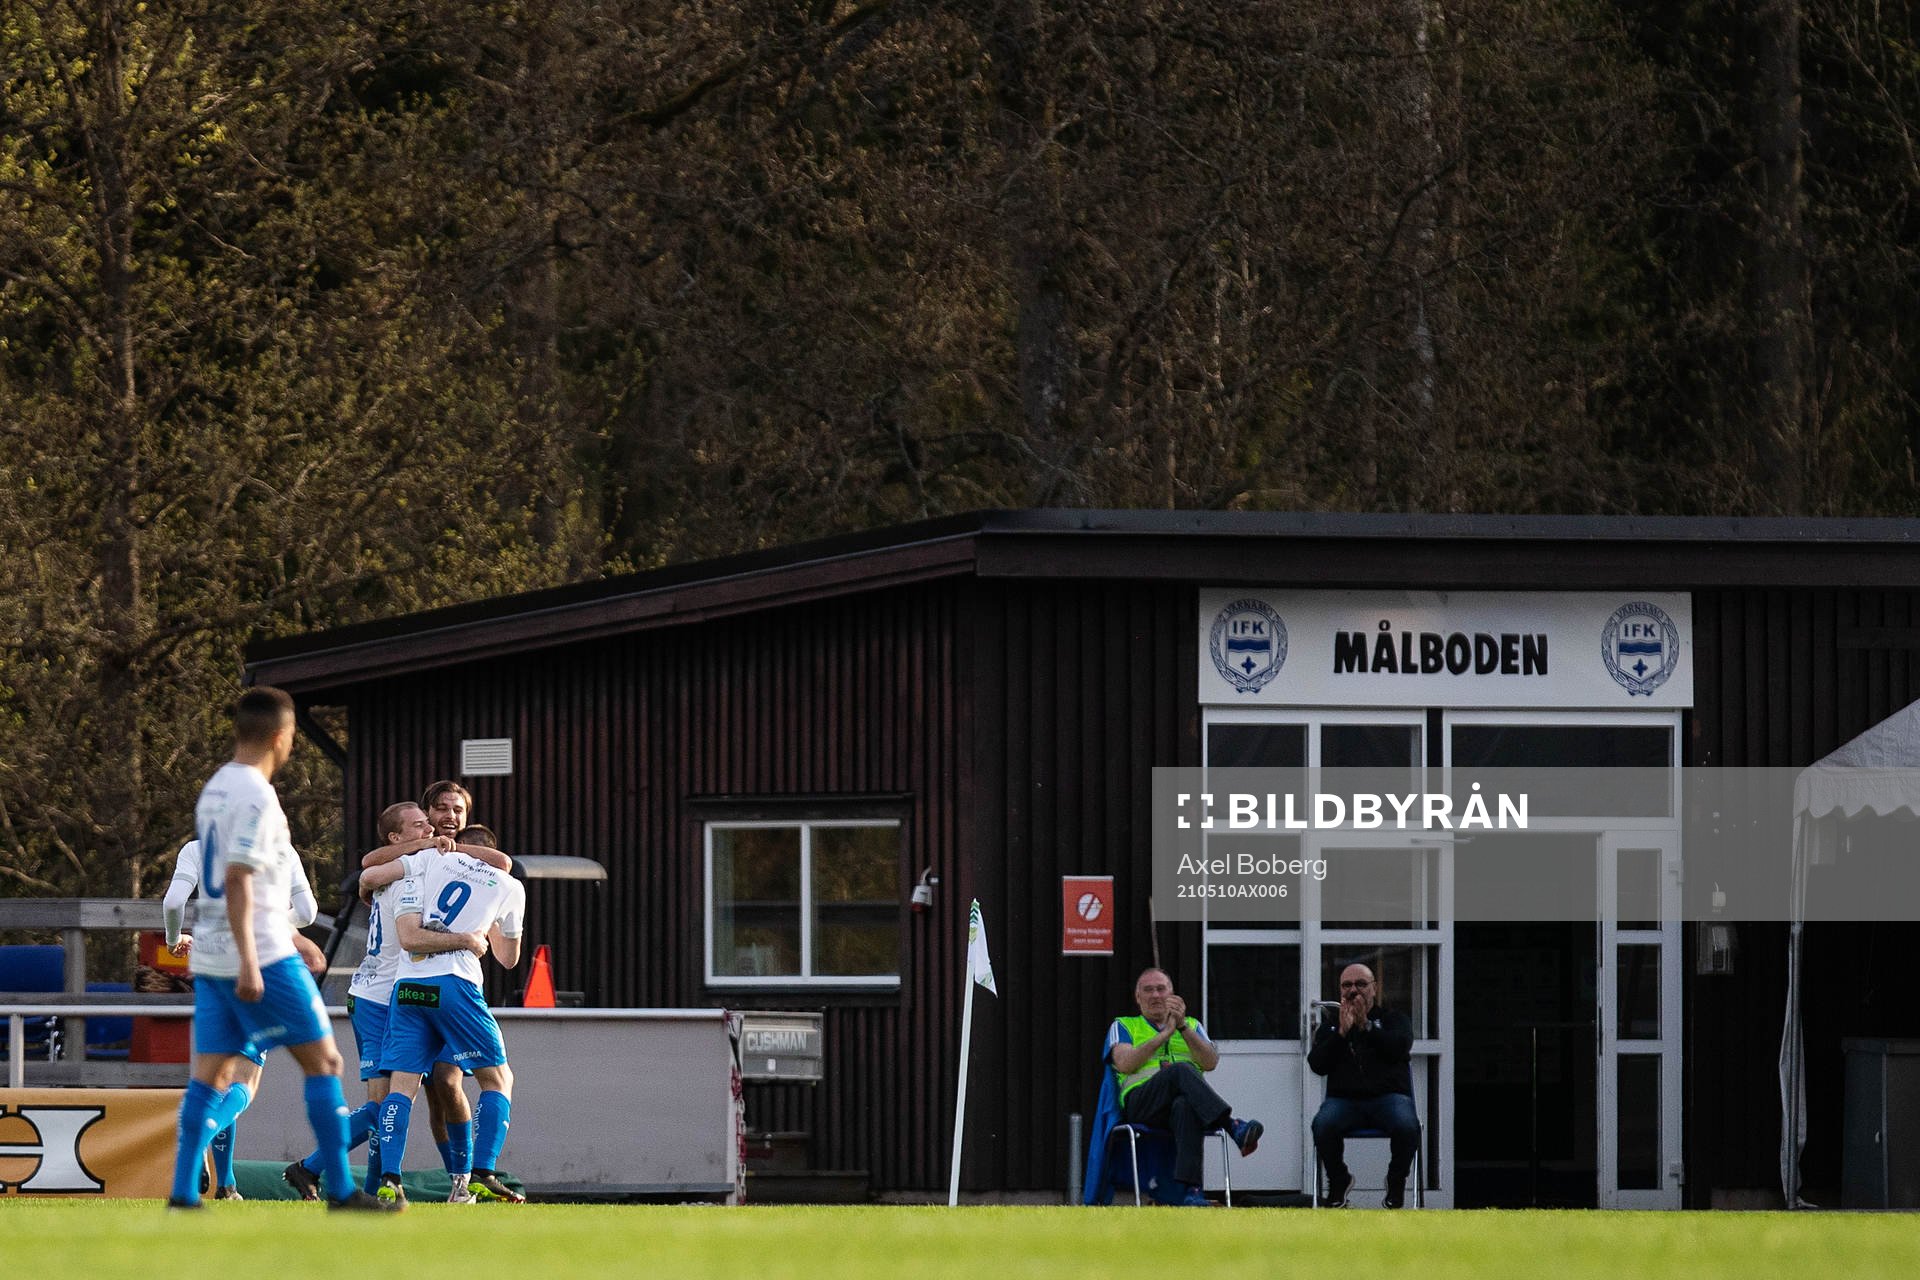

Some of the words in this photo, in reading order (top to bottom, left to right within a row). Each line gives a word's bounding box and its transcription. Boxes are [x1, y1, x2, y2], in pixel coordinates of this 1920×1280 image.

[1233, 620, 1265, 635] IFK
[1624, 623, 1656, 638] IFK
[1333, 619, 1549, 676] MÅLBODEN
[430, 880, 473, 927] 9
[747, 1031, 807, 1051] CUSHMAN
[382, 1104, 399, 1132] office
[381, 1135, 392, 1143] 4
